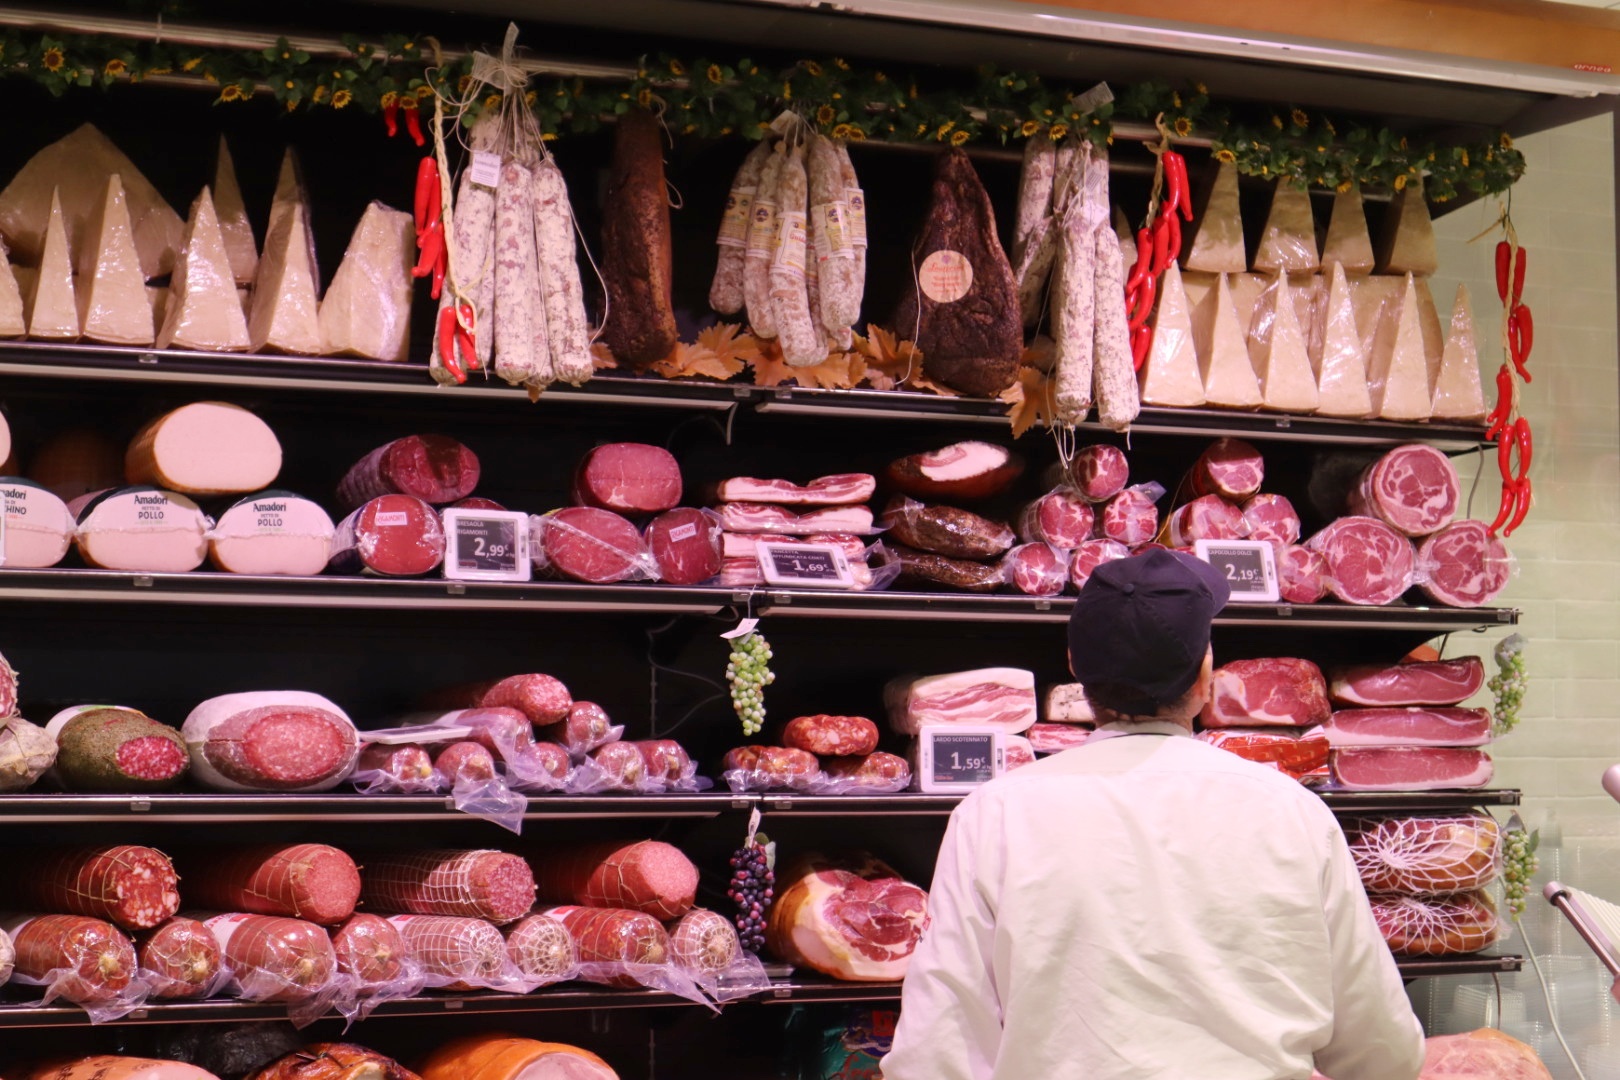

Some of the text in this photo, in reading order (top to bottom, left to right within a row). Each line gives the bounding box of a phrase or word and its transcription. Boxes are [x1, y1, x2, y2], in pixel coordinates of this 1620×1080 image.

[134, 495, 168, 505] Amadori
[5, 505, 27, 515] HINO
[253, 503, 286, 512] Amadori
[138, 512, 164, 520] POLLO
[257, 519, 282, 527] POLLO
